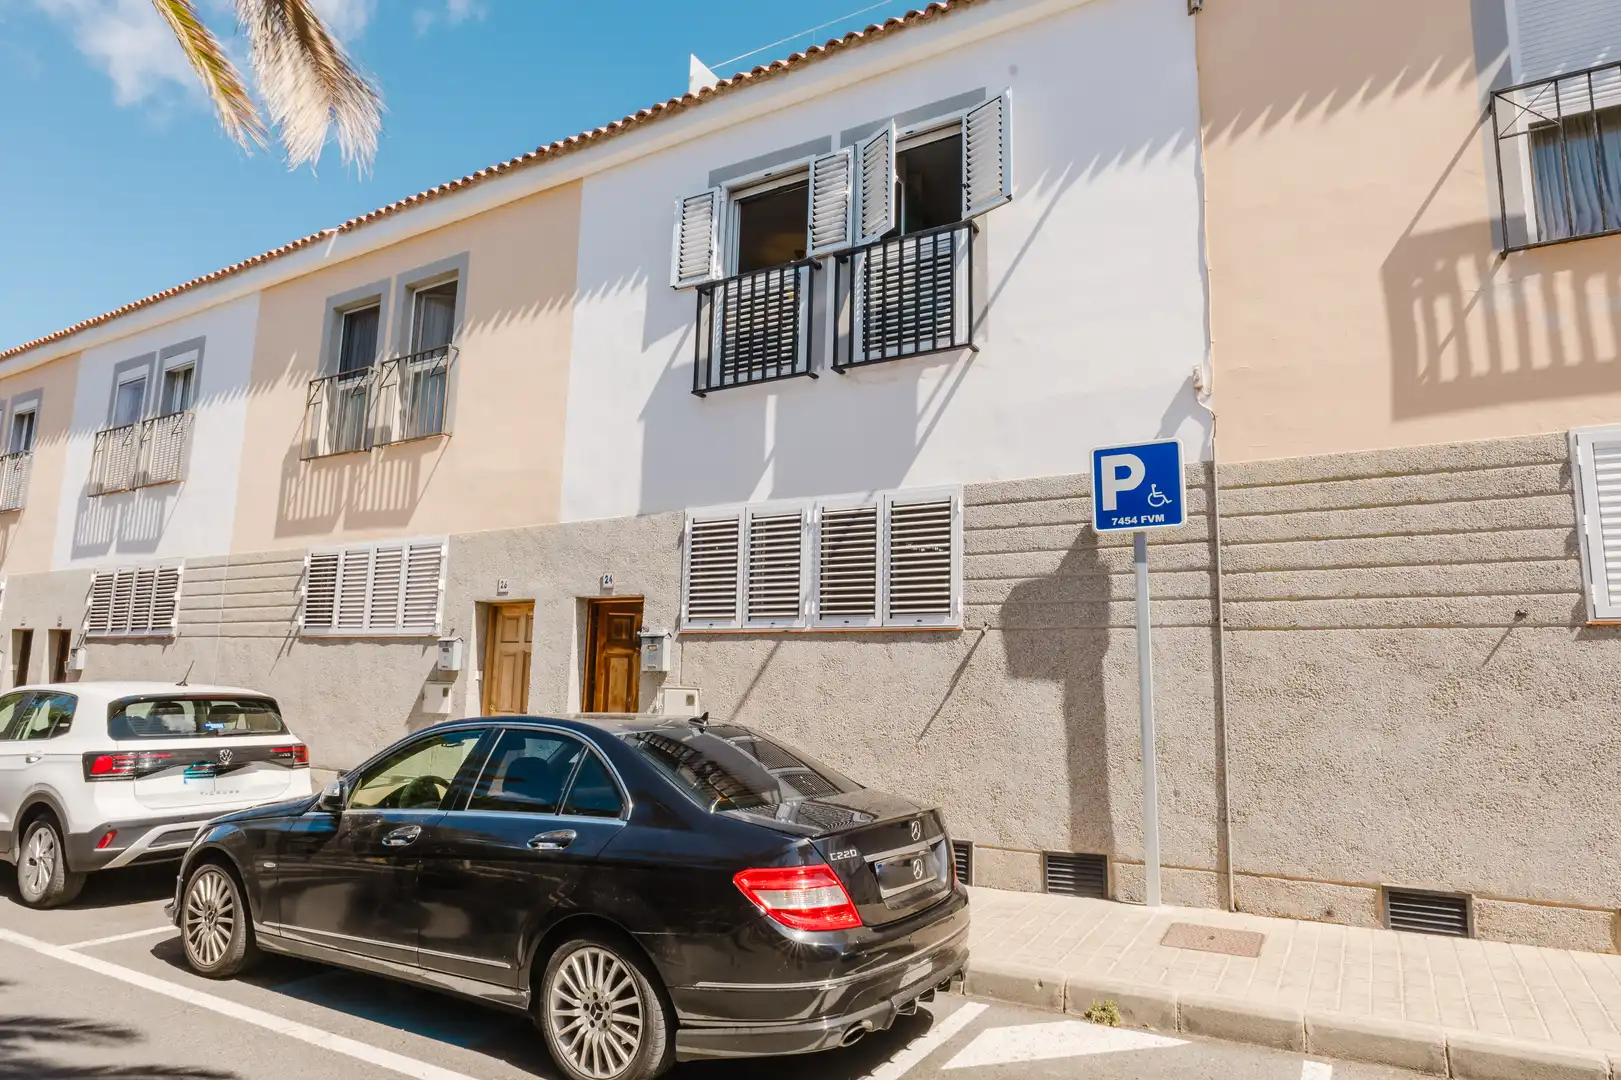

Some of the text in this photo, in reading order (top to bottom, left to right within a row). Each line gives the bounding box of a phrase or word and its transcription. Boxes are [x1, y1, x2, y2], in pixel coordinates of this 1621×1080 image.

[1101, 453, 1146, 511] P
[1111, 513, 1165, 526] 7454 FVM
[500, 580, 508, 589] 26
[604, 574, 613, 584] 24
[828, 849, 858, 862] C220
